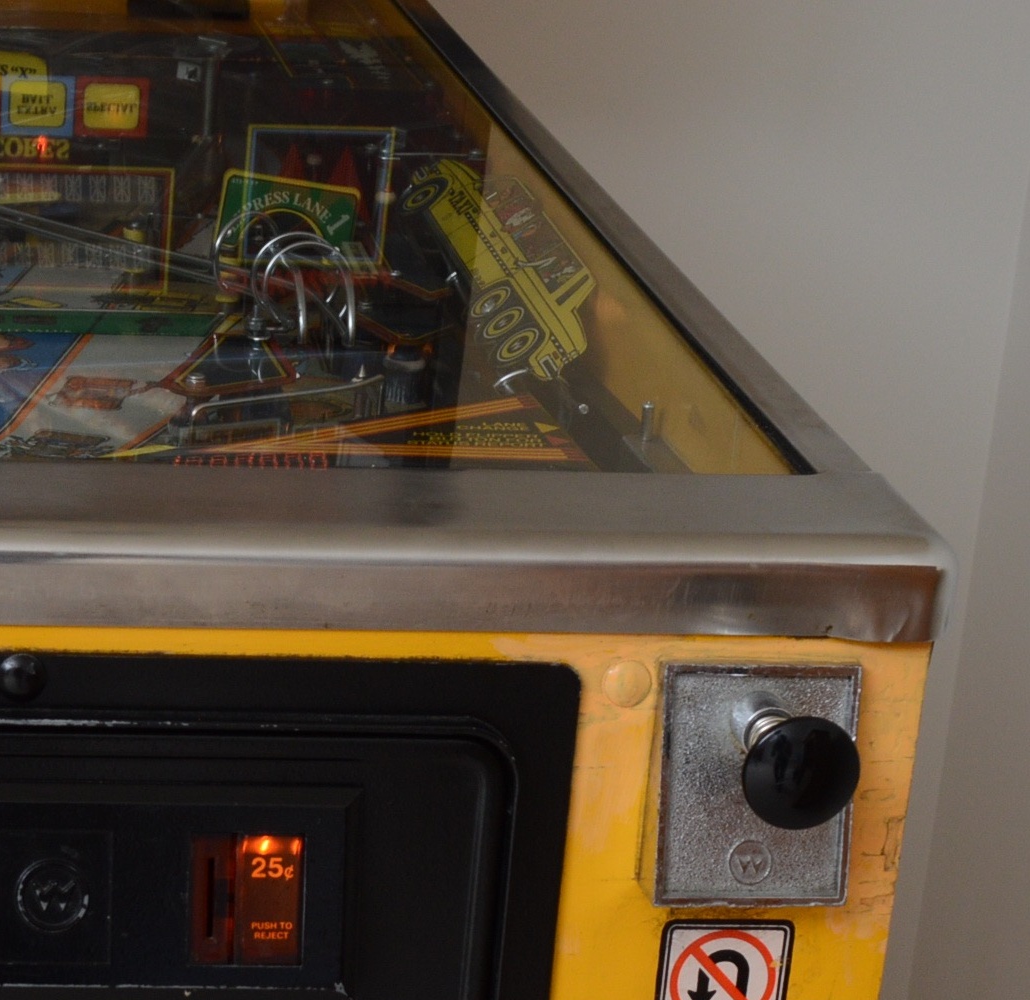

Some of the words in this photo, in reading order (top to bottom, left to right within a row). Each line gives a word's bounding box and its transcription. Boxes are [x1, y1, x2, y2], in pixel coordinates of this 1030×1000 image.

[293, 192, 333, 224] LANE
[327, 213, 351, 236] 1
[251, 857, 294, 880] 25¢
[251, 922, 277, 930] PUSH
[280, 922, 293, 930] TO
[254, 931, 290, 940] REJECT
